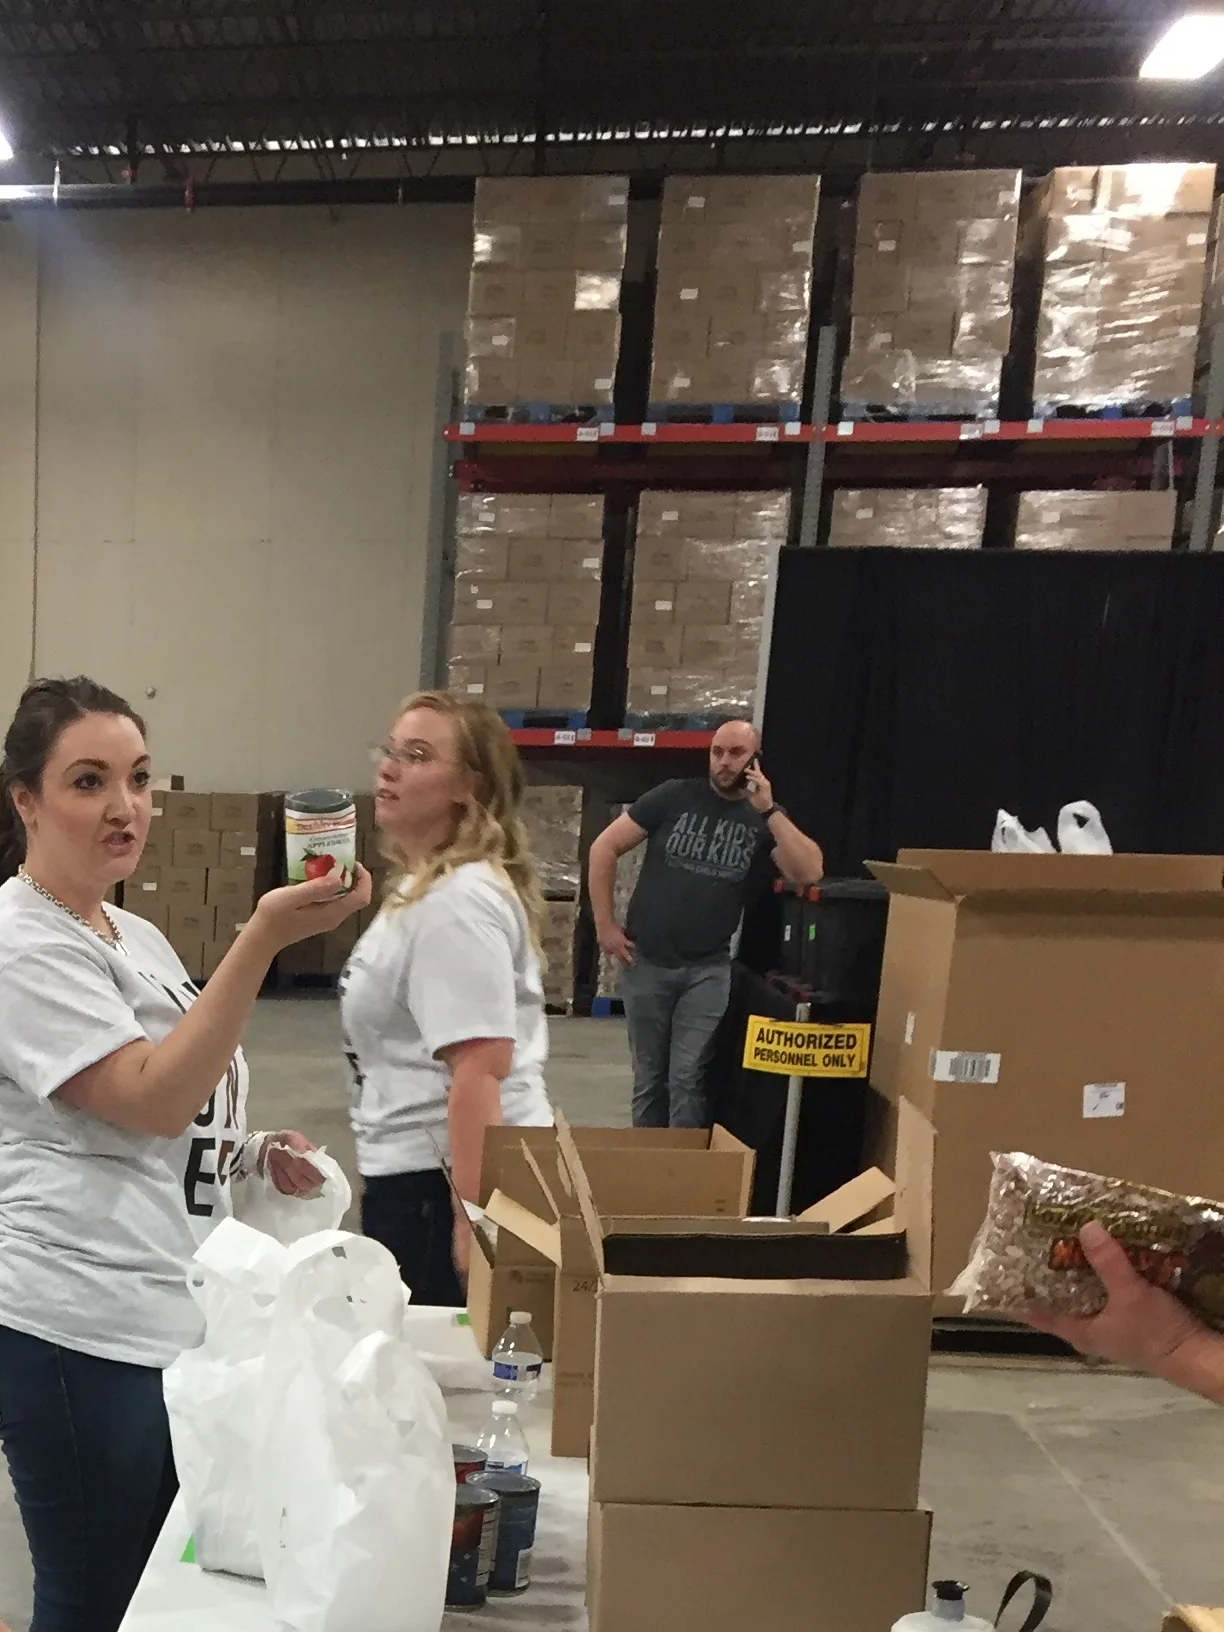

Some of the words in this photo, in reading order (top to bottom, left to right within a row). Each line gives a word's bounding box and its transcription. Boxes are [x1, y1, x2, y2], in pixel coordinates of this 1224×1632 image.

[672, 811, 708, 838] ALL
[713, 818, 758, 846] KIDS
[666, 832, 707, 860] OUR
[706, 840, 755, 870] KIDS
[756, 1027, 858, 1050] AUTHORIZED
[753, 1047, 818, 1067] PERSONNEL
[822, 1052, 857, 1068] ONLY
